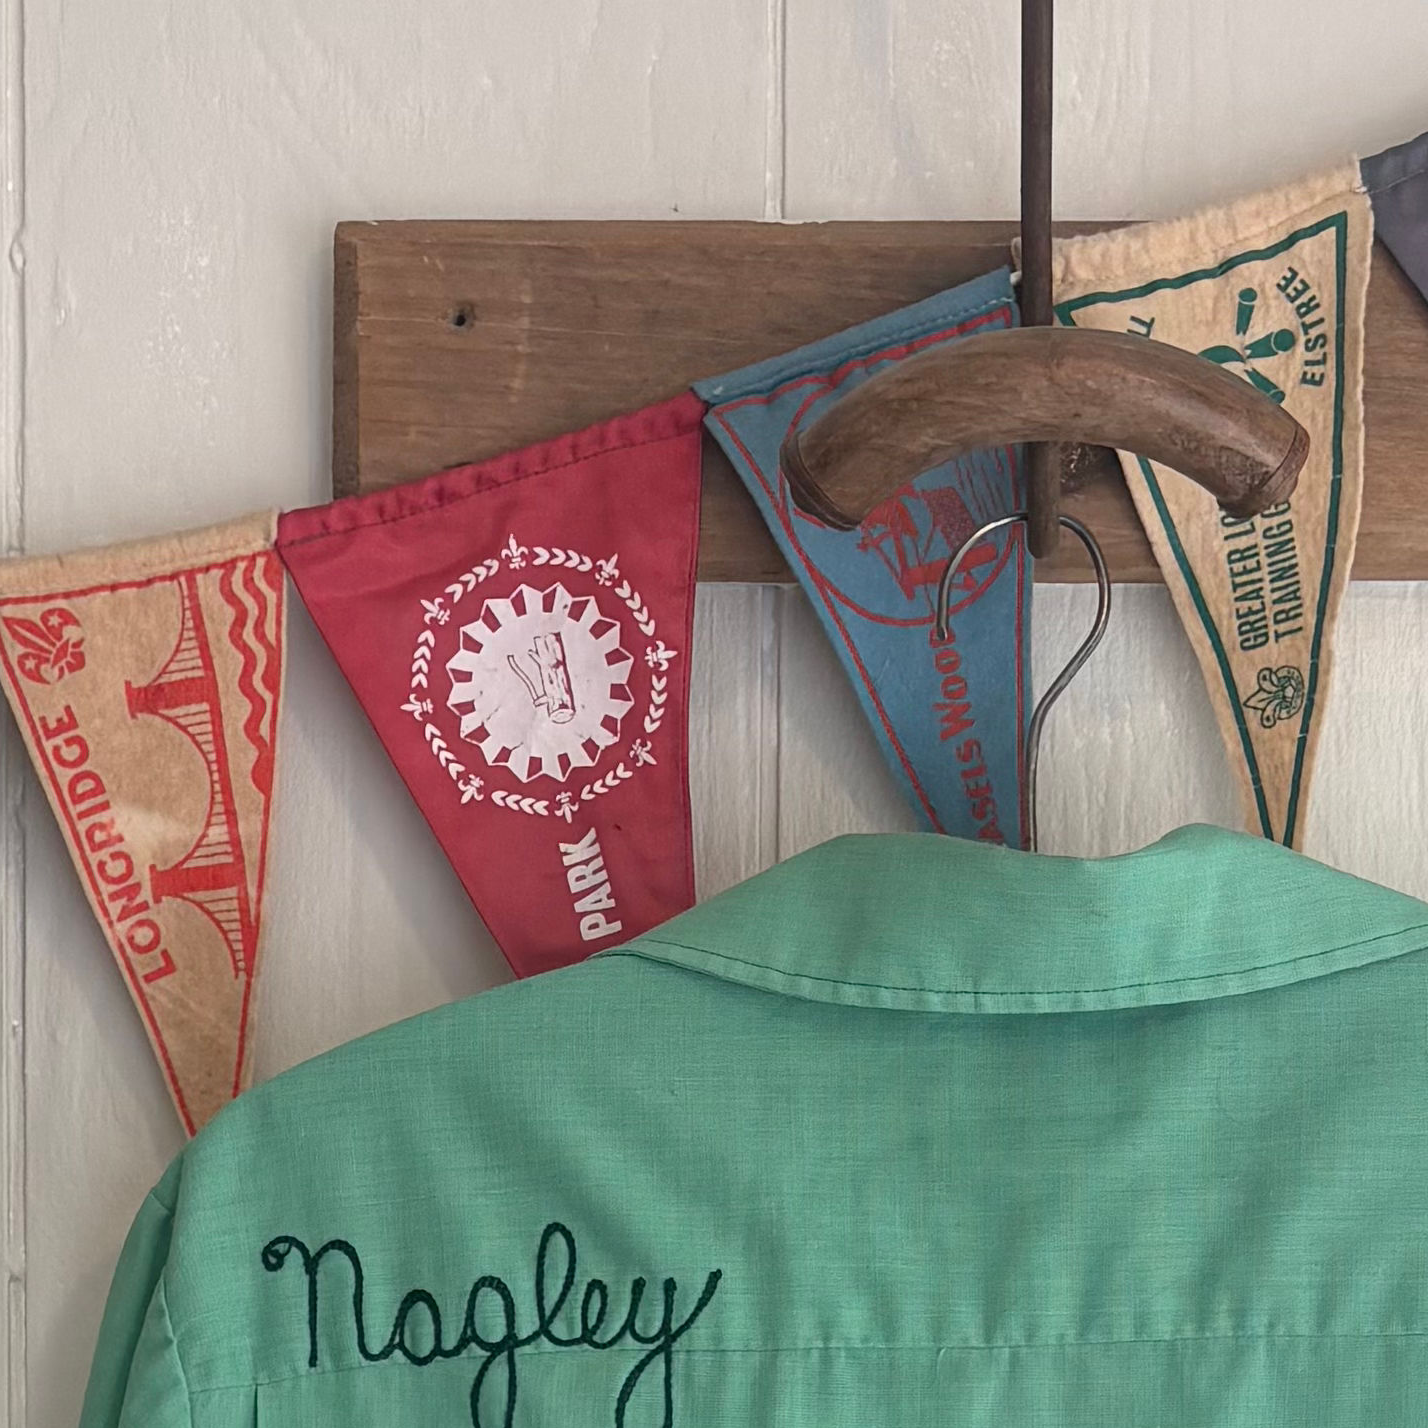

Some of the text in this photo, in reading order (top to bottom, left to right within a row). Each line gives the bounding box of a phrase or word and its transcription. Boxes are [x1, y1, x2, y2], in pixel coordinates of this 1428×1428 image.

[1276, 266, 1328, 387] ELSTREE
[1227, 543, 1270, 652] GREATER
[1262, 518, 1304, 644] TRAINING
[559, 827, 622, 941] PARK
